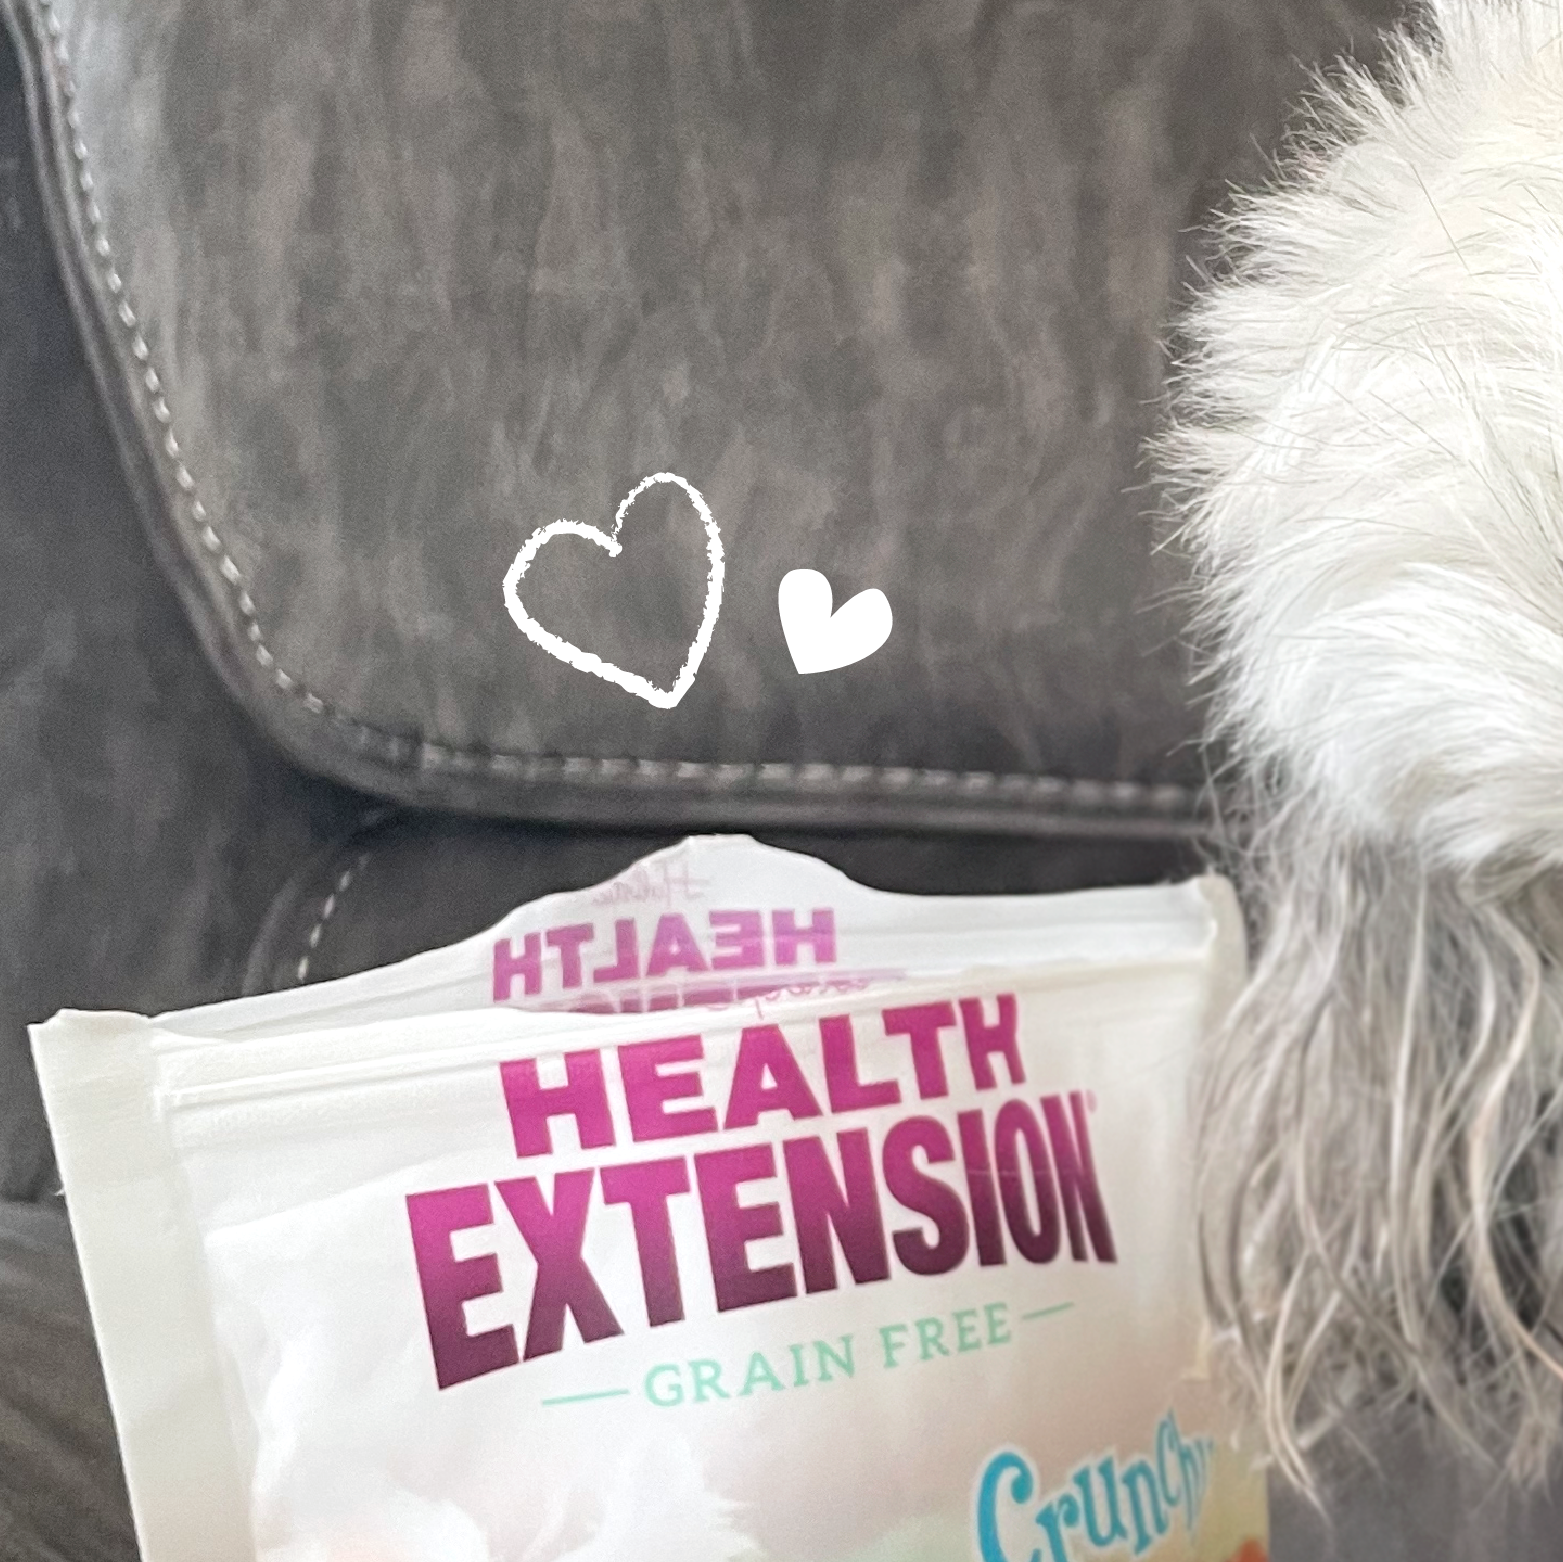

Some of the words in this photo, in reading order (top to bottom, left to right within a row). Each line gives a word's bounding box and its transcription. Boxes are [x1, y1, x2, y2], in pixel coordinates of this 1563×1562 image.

[499, 993, 1026, 1159] HEALTH
[405, 1089, 1117, 1390] EXTENSION
[643, 1334, 859, 1407] GRAIN
[879, 1302, 1014, 1370] FREE
